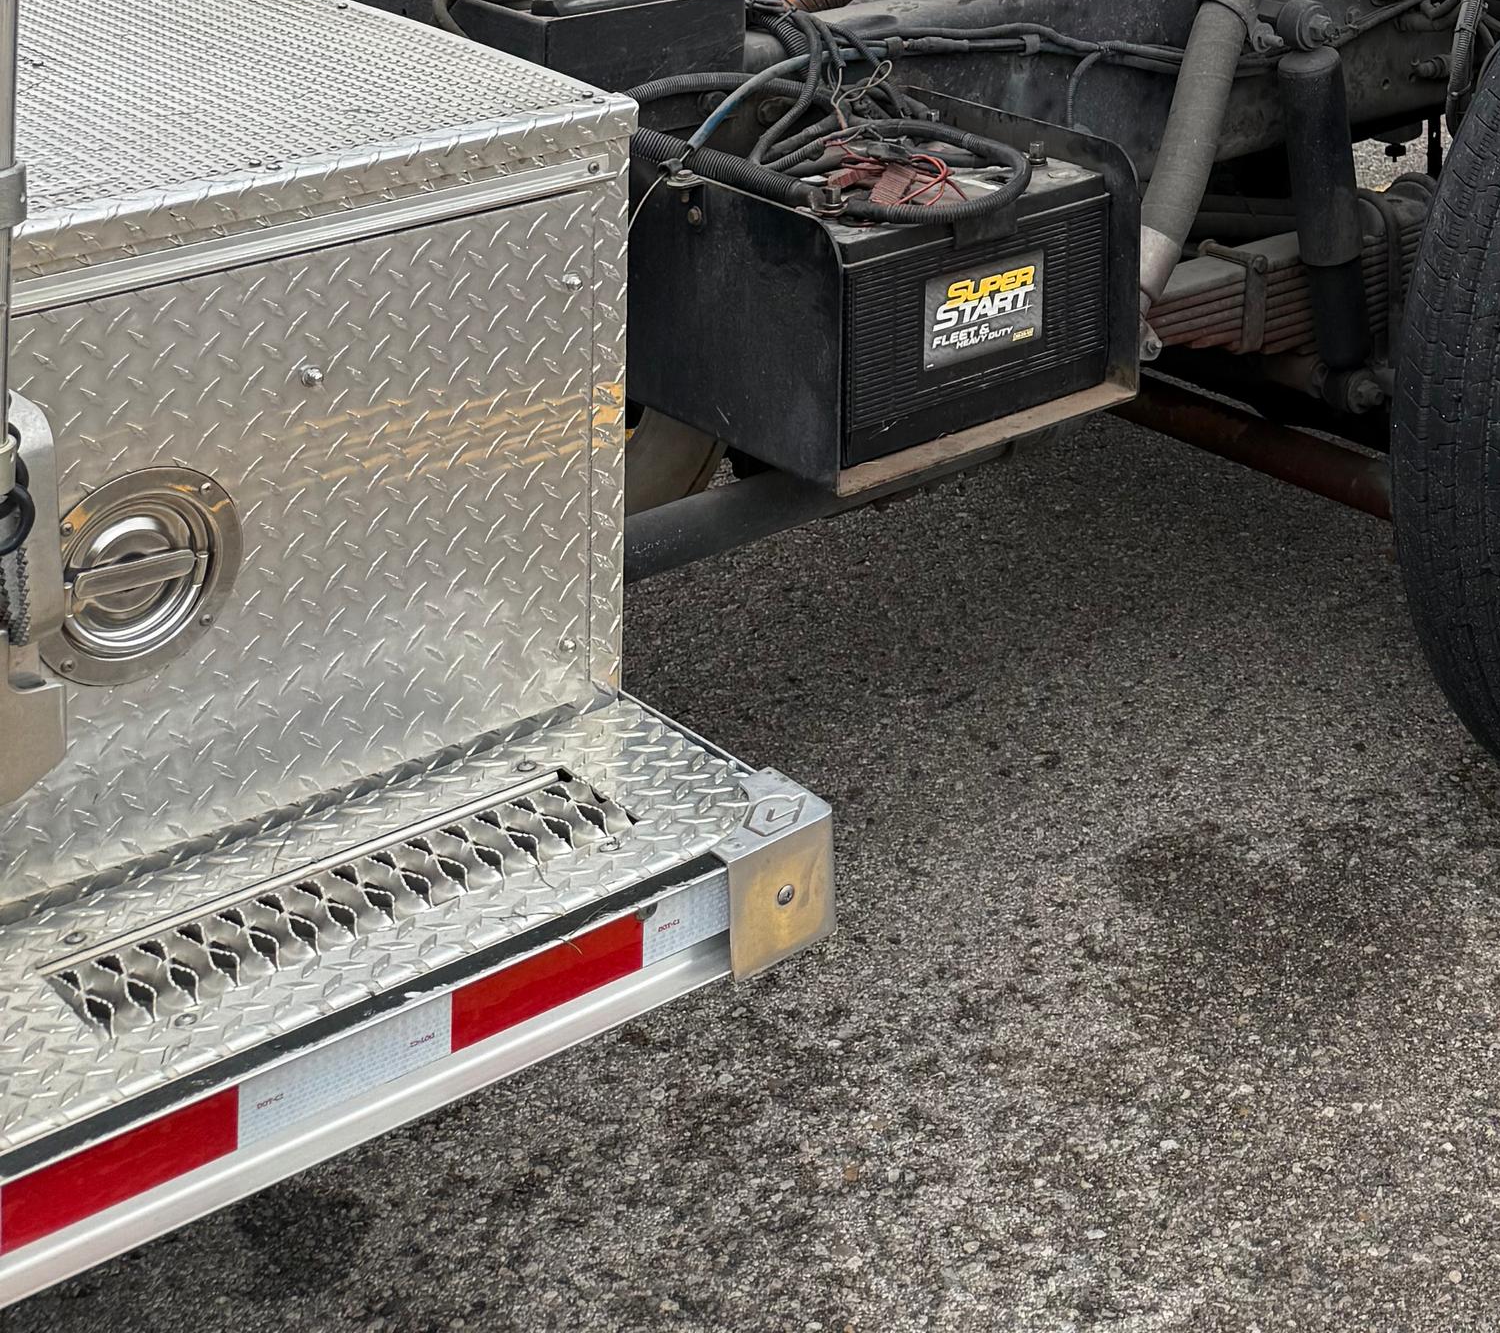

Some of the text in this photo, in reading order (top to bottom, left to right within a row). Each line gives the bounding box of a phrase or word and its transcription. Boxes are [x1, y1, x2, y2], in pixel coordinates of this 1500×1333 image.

[945, 265, 1035, 308] SUPER
[932, 284, 1036, 332] START
[932, 323, 990, 349] FLEET &
[956, 332, 988, 349] HEAVY
[988, 326, 1013, 340] DUTY
